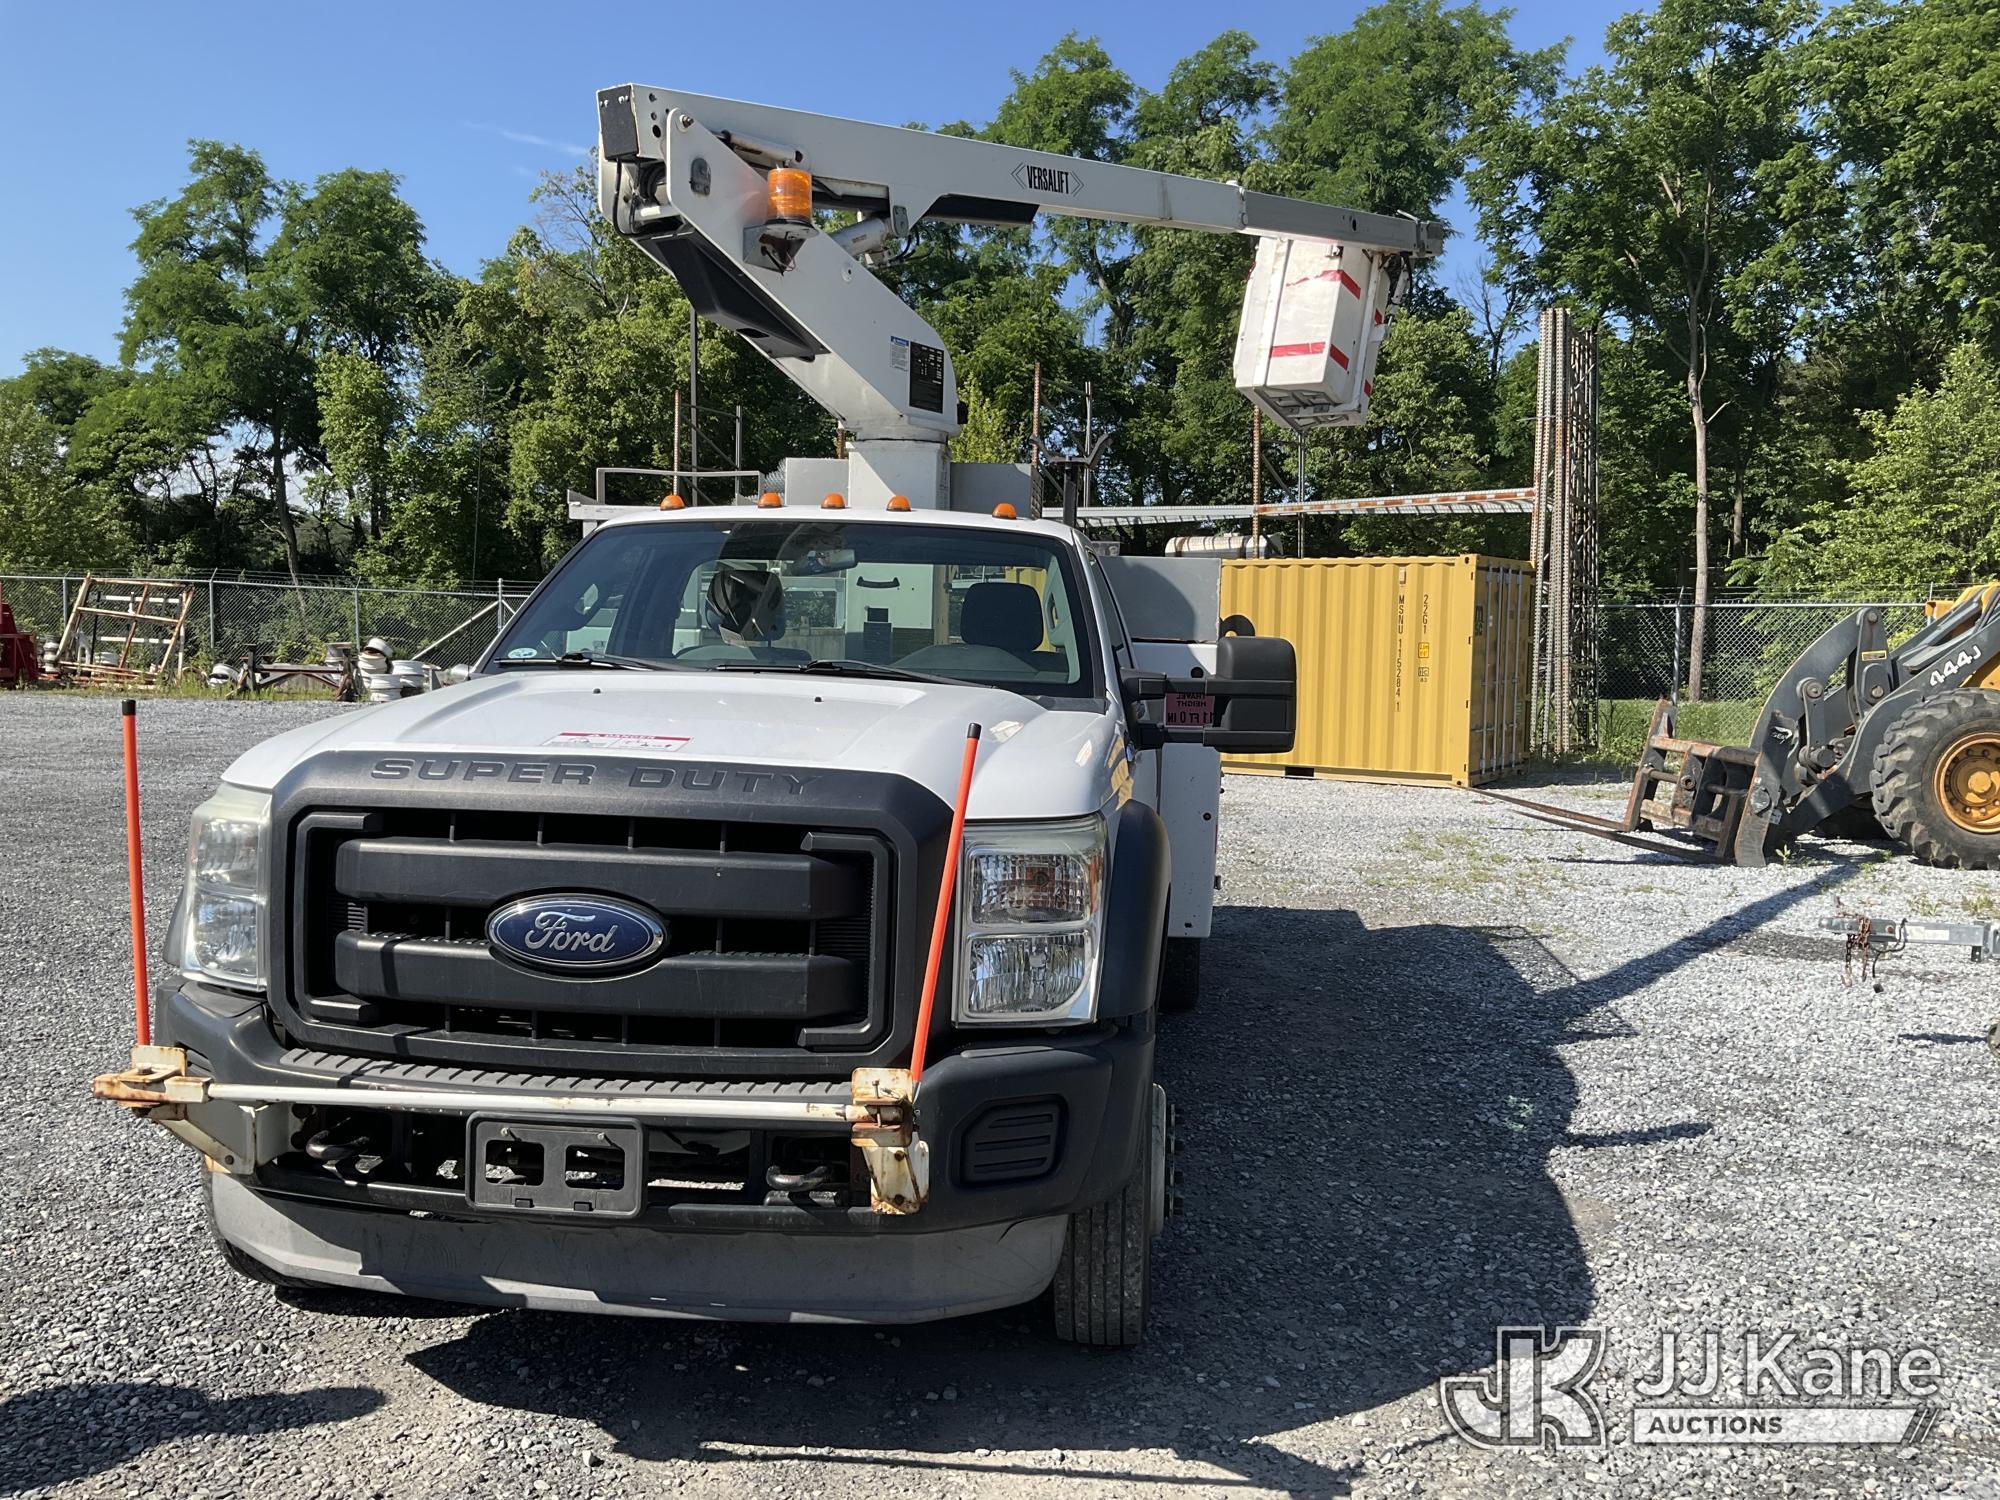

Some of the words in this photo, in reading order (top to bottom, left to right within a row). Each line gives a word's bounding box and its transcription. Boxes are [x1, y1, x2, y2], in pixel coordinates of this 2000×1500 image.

[1027, 165, 1069, 194] VERSALIFT
[1397, 594, 1405, 635] MSNU
[1930, 645, 1982, 687] 444J
[371, 759, 596, 784] SUPER
[629, 767, 823, 794] DUTY
[525, 911, 618, 953] Ford
